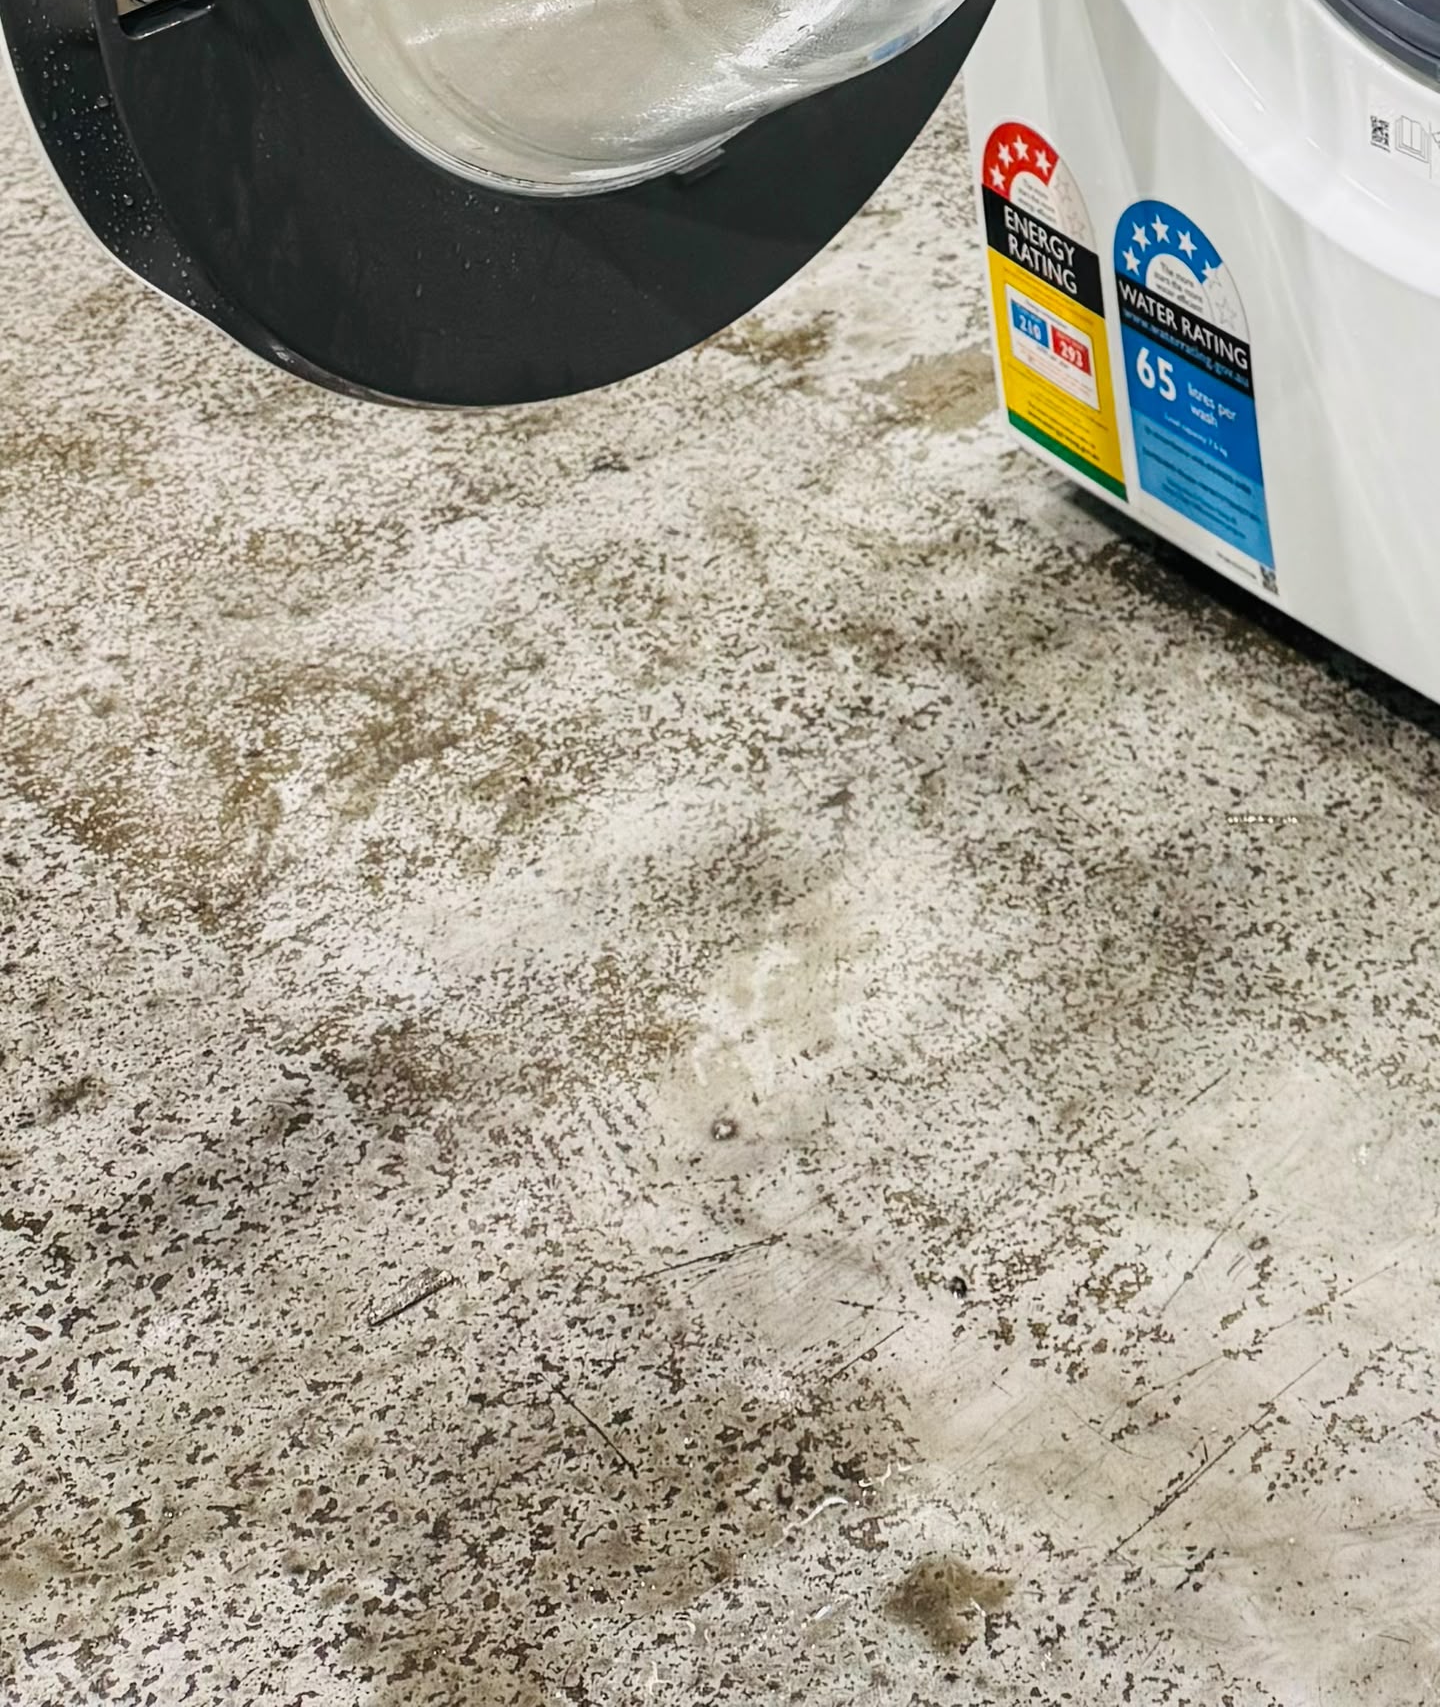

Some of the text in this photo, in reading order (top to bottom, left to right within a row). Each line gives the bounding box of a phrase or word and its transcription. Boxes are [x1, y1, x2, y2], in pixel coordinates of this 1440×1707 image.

[1004, 205, 1075, 267] ENERGY
[1008, 235, 1078, 295] RATING
[1118, 279, 1178, 331] WATER
[1181, 316, 1249, 371] RATING
[1136, 346, 1177, 402] 65
